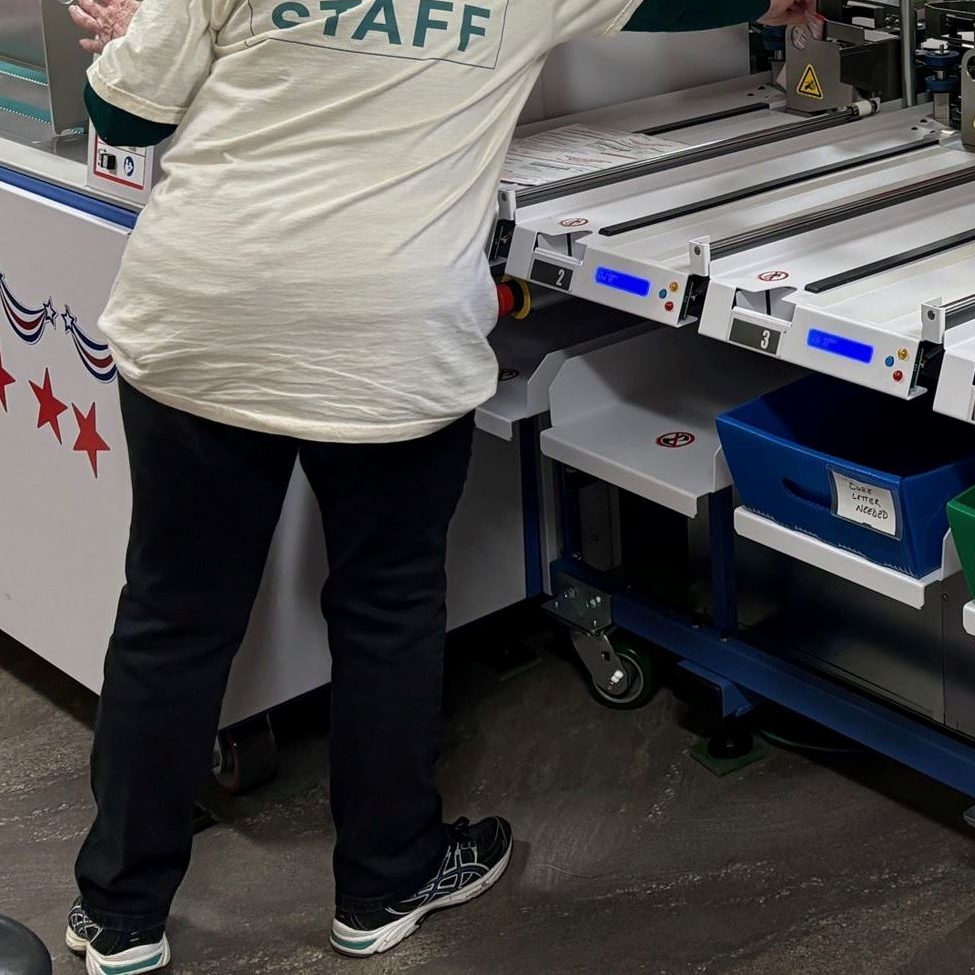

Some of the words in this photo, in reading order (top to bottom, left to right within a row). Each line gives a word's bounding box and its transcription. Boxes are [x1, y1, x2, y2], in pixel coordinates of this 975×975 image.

[555, 268, 565, 286] 2
[760, 329, 771, 349] 3
[852, 493, 881, 507] LETTER
[855, 505, 889, 519] NEEDED
